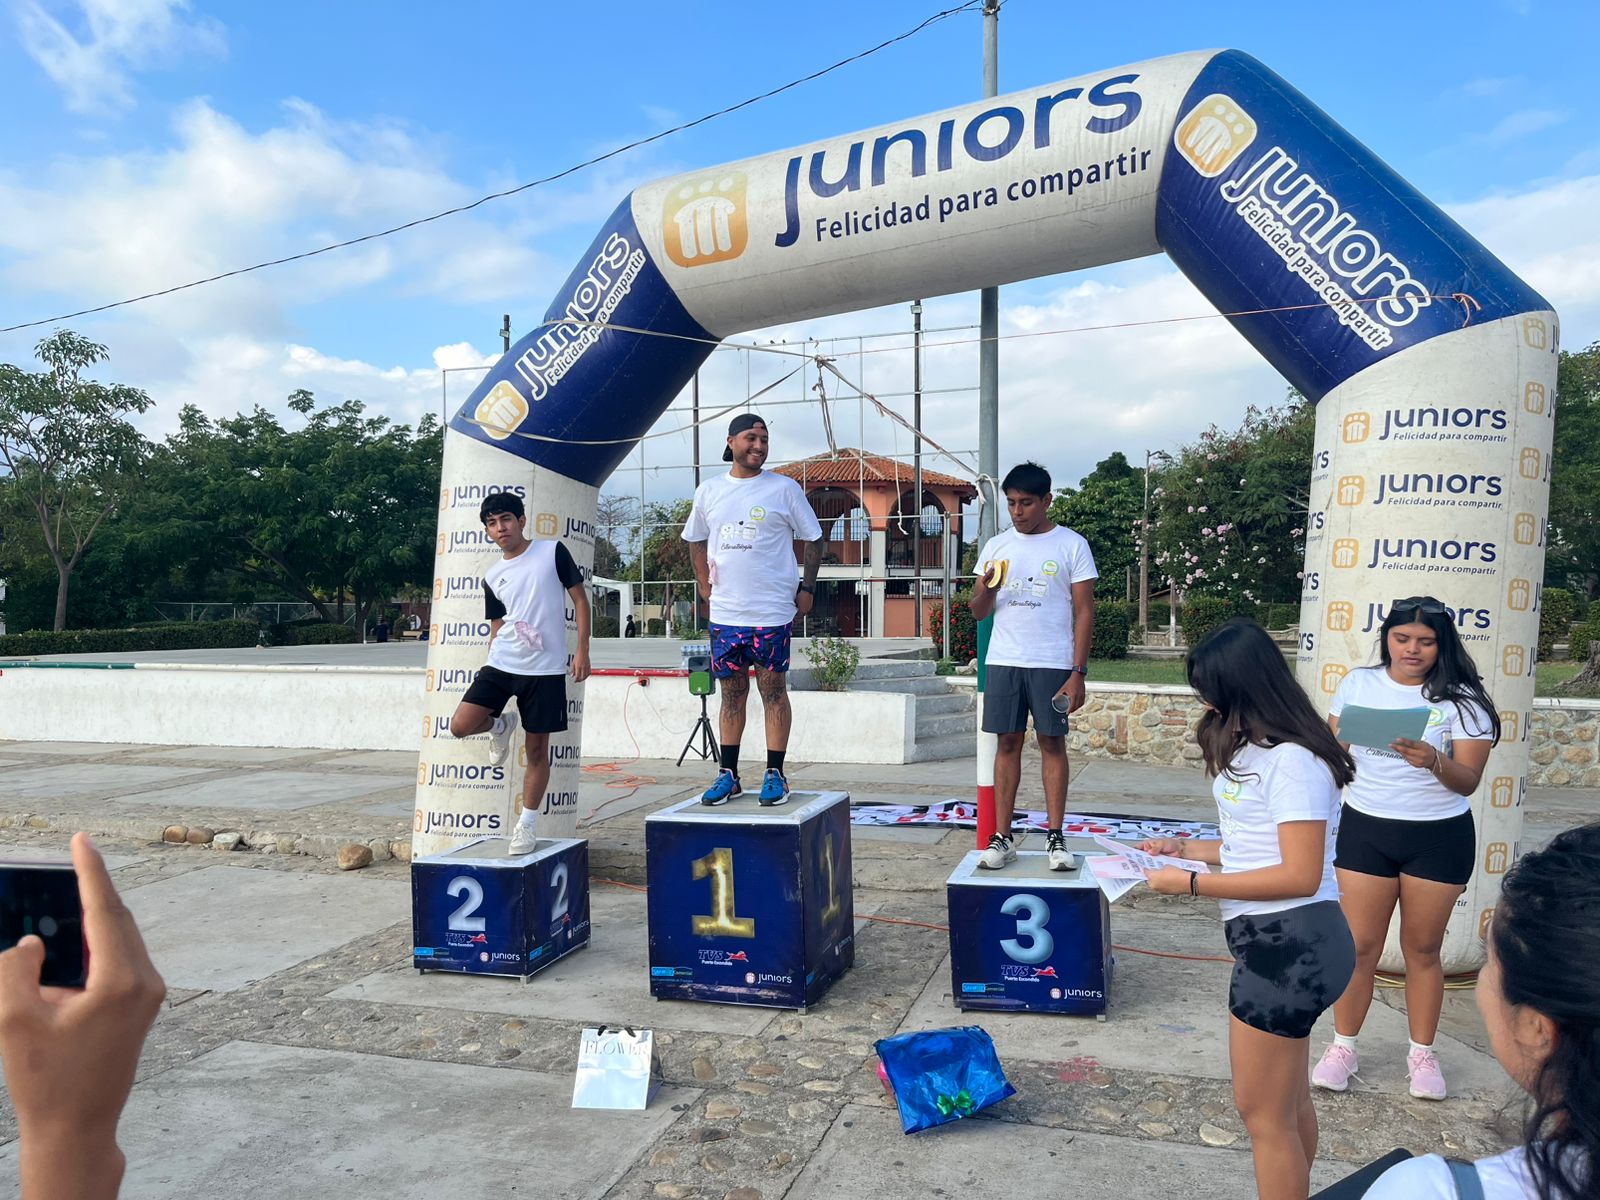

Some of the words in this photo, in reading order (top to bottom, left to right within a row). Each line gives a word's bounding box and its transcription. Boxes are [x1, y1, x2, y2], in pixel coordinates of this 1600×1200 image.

[815, 194, 931, 242] Felicidad
[938, 187, 998, 223] para
[1006, 146, 1152, 201] compartir
[1240, 199, 1301, 259] Felicidad
[1290, 254, 1326, 288] para
[1322, 284, 1389, 347] compartir
[546, 333, 591, 384] Felicidad
[604, 251, 644, 311] compartir
[1393, 432, 1438, 440] Felicidad
[1439, 433, 1461, 441] para
[1463, 434, 1507, 443] compartir
[1388, 498, 1432, 506] Felicidad
[1433, 499, 1456, 507] para
[1458, 500, 1502, 509] compartir
[563, 517, 596, 538] junio
[448, 530, 494, 553] juni
[1382, 562, 1427, 570] Felicidad
[1428, 564, 1450, 572] para
[1452, 566, 1496, 575] compartir
[444, 576, 485, 598] juni
[1362, 603, 1490, 632] jurs
[440, 622, 491, 645] junio
[1458, 634, 1490, 642] mpartir
[437, 669, 480, 691] juni
[549, 745, 580, 768] junio
[543, 792, 578, 815] junio
[820, 833, 840, 927] 1
[550, 862, 569, 922] 2
[692, 848, 755, 938] 1
[446, 876, 486, 932] 2
[445, 932, 466, 943] TVS
[1000, 894, 1054, 964] 3
[698, 949, 724, 960] TVS
[1001, 964, 1029, 977] TVS
